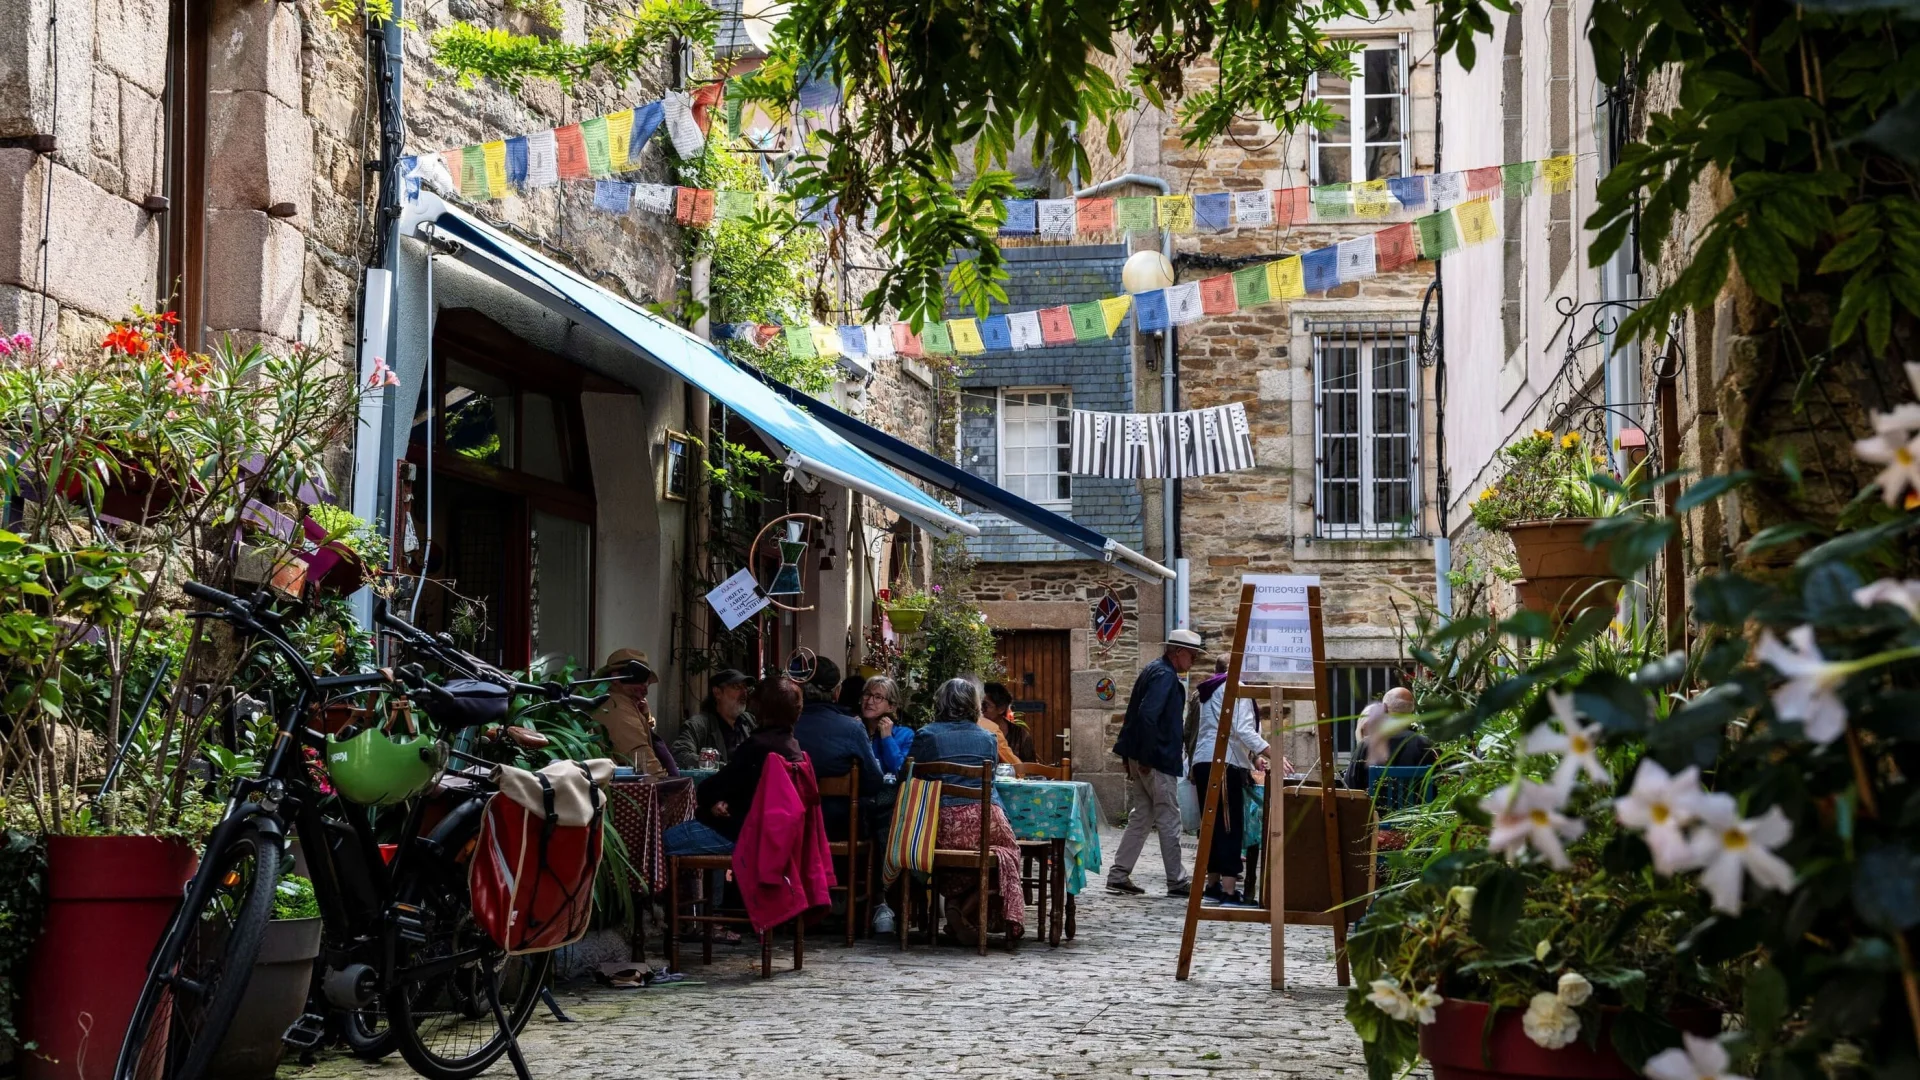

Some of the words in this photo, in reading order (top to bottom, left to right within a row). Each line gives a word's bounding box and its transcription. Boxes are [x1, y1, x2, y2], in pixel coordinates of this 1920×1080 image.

[719, 607, 727, 615] DE
[729, 592, 748, 608] JARDIN
[725, 587, 744, 603] OBJETS
